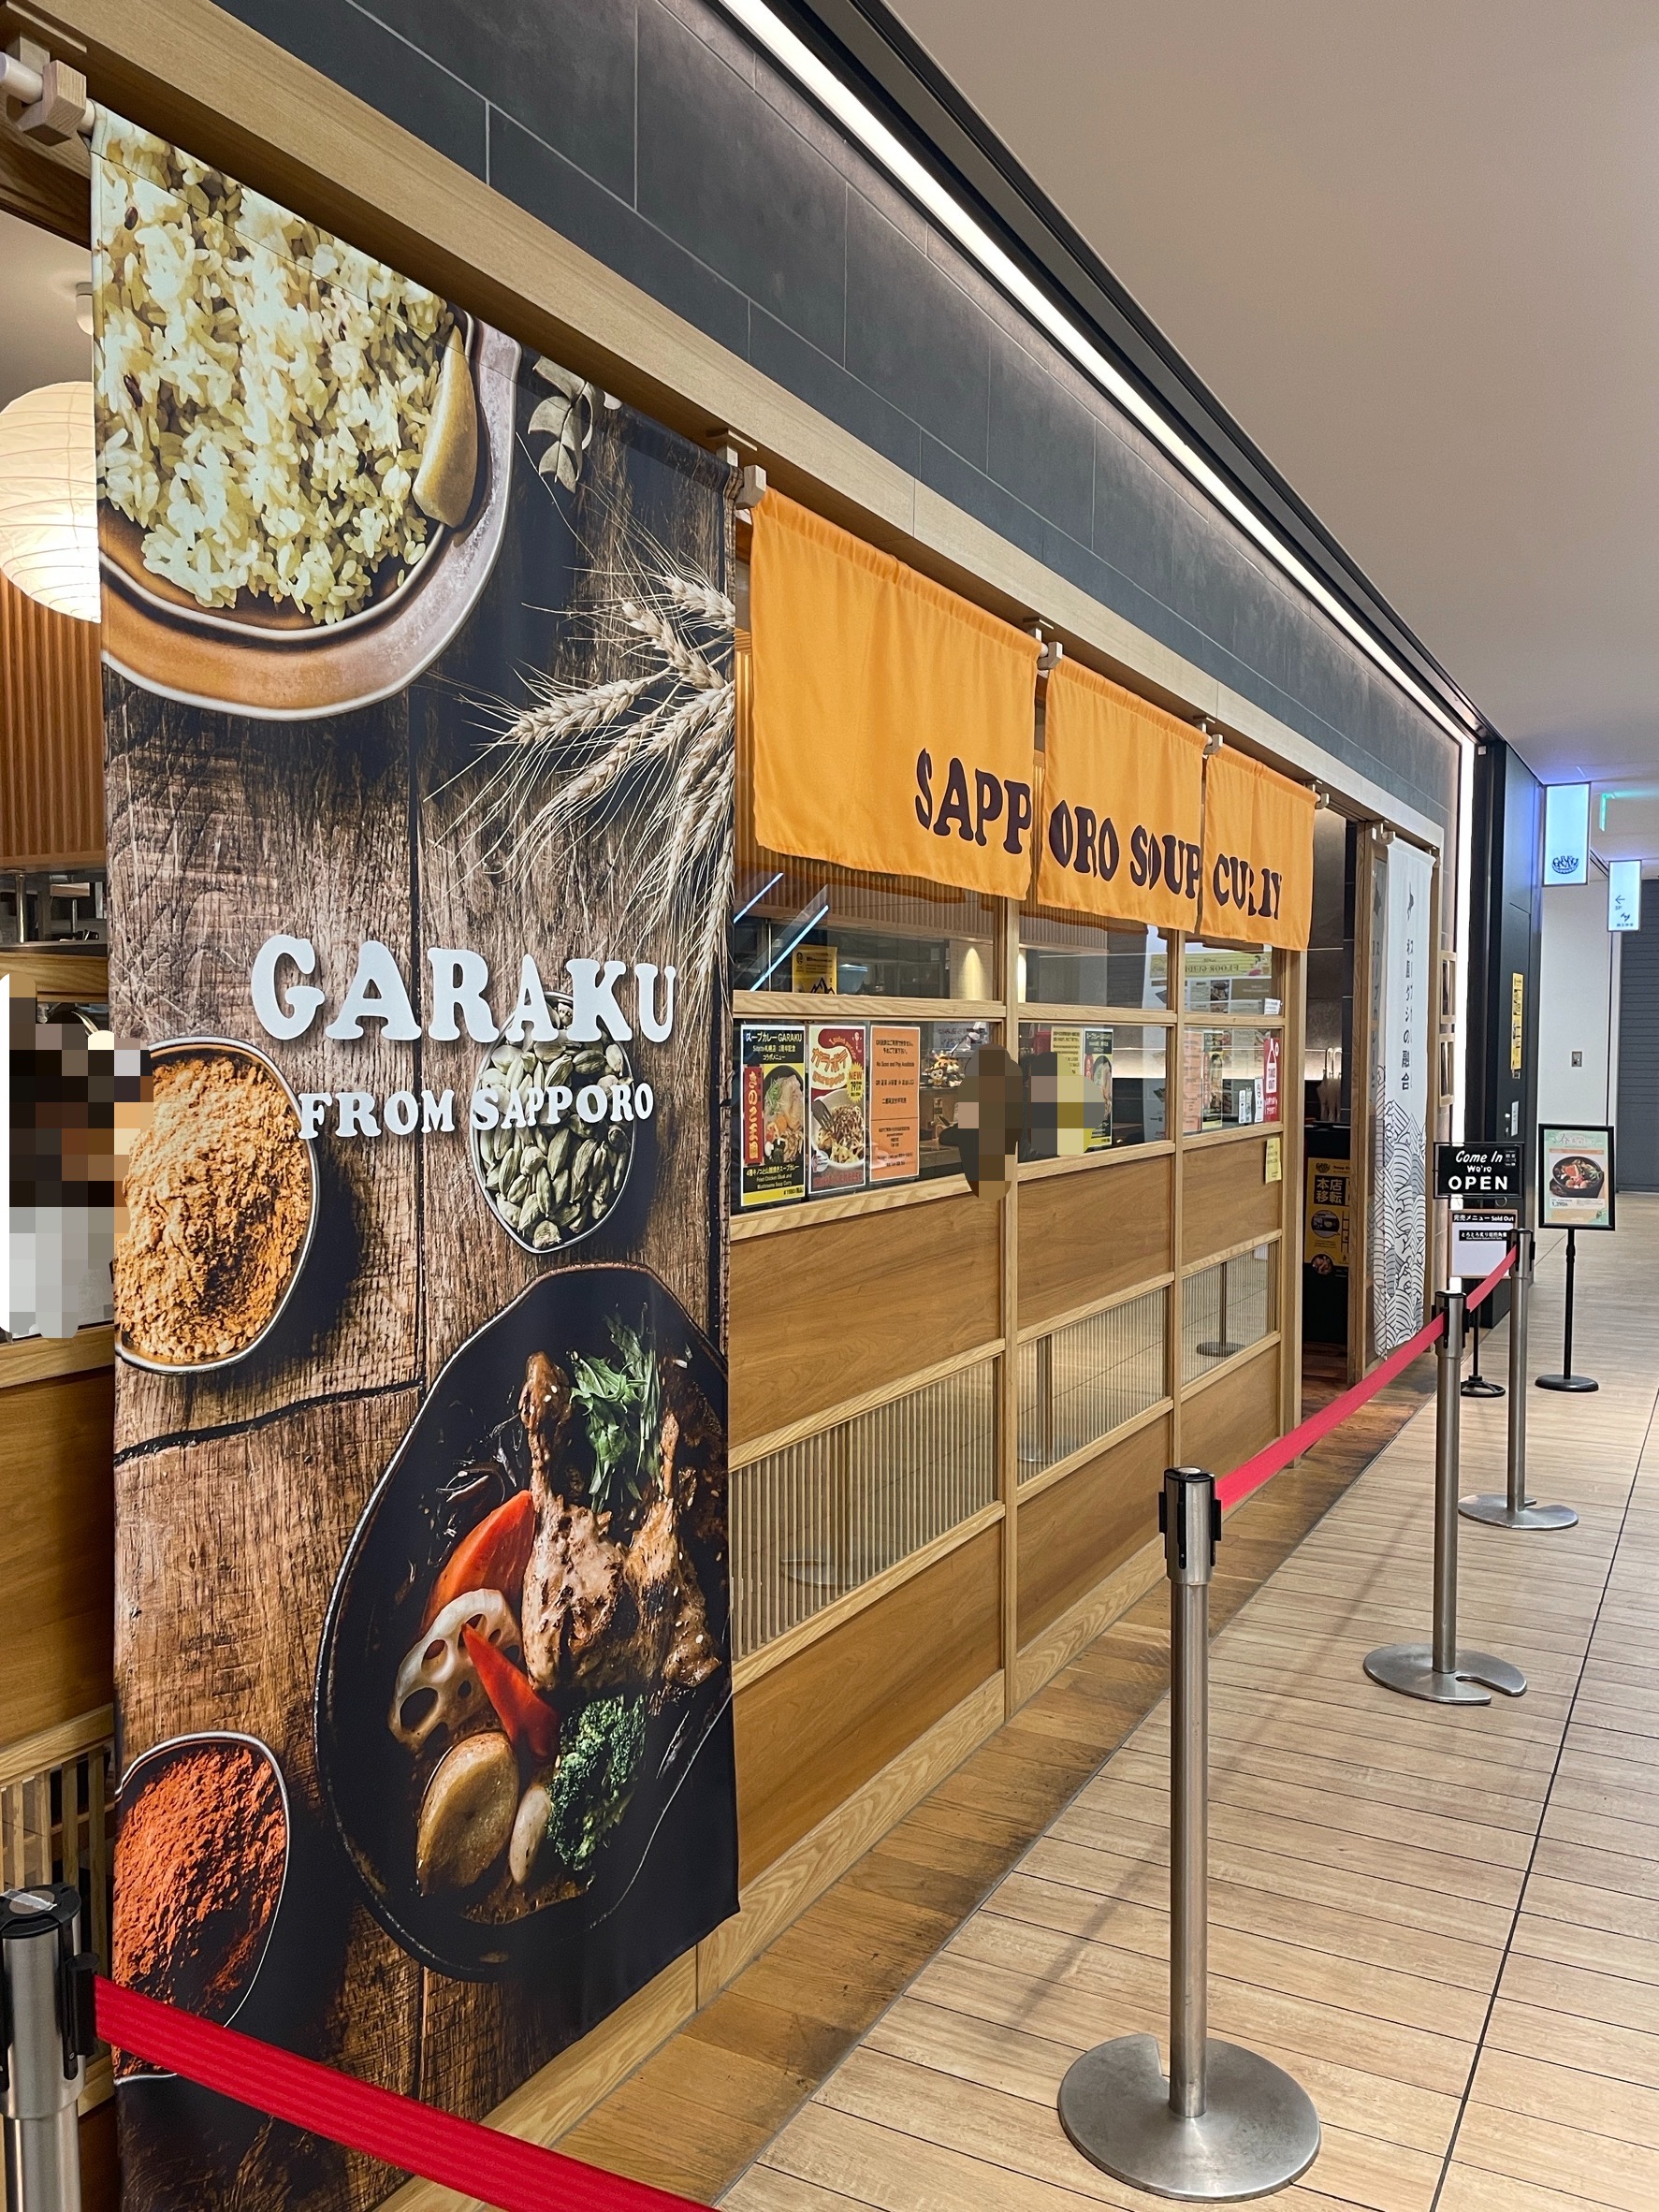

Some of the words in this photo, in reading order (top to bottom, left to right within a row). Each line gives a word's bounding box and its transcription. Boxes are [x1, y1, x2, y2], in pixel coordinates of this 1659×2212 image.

[915, 748, 1120, 881] SAPPORO
[1130, 824, 1201, 899] SOUP
[251, 934, 677, 1043] GARAKU
[778, 1033, 803, 1042] GARAKU
[849, 1070, 863, 1081] NEW
[298, 1089, 456, 1140] FROM
[471, 1083, 654, 1130] SAPPORO
[1455, 1150, 1488, 1163] Come
[1491, 1150, 1503, 1163] In
[1466, 1164, 1492, 1173] We're
[1317, 1178, 1343, 1191] 本店
[1448, 1175, 1508, 1190] OPEN
[1316, 1190, 1342, 1204] 移転
[1453, 1214, 1491, 1222] 完売メニュー
